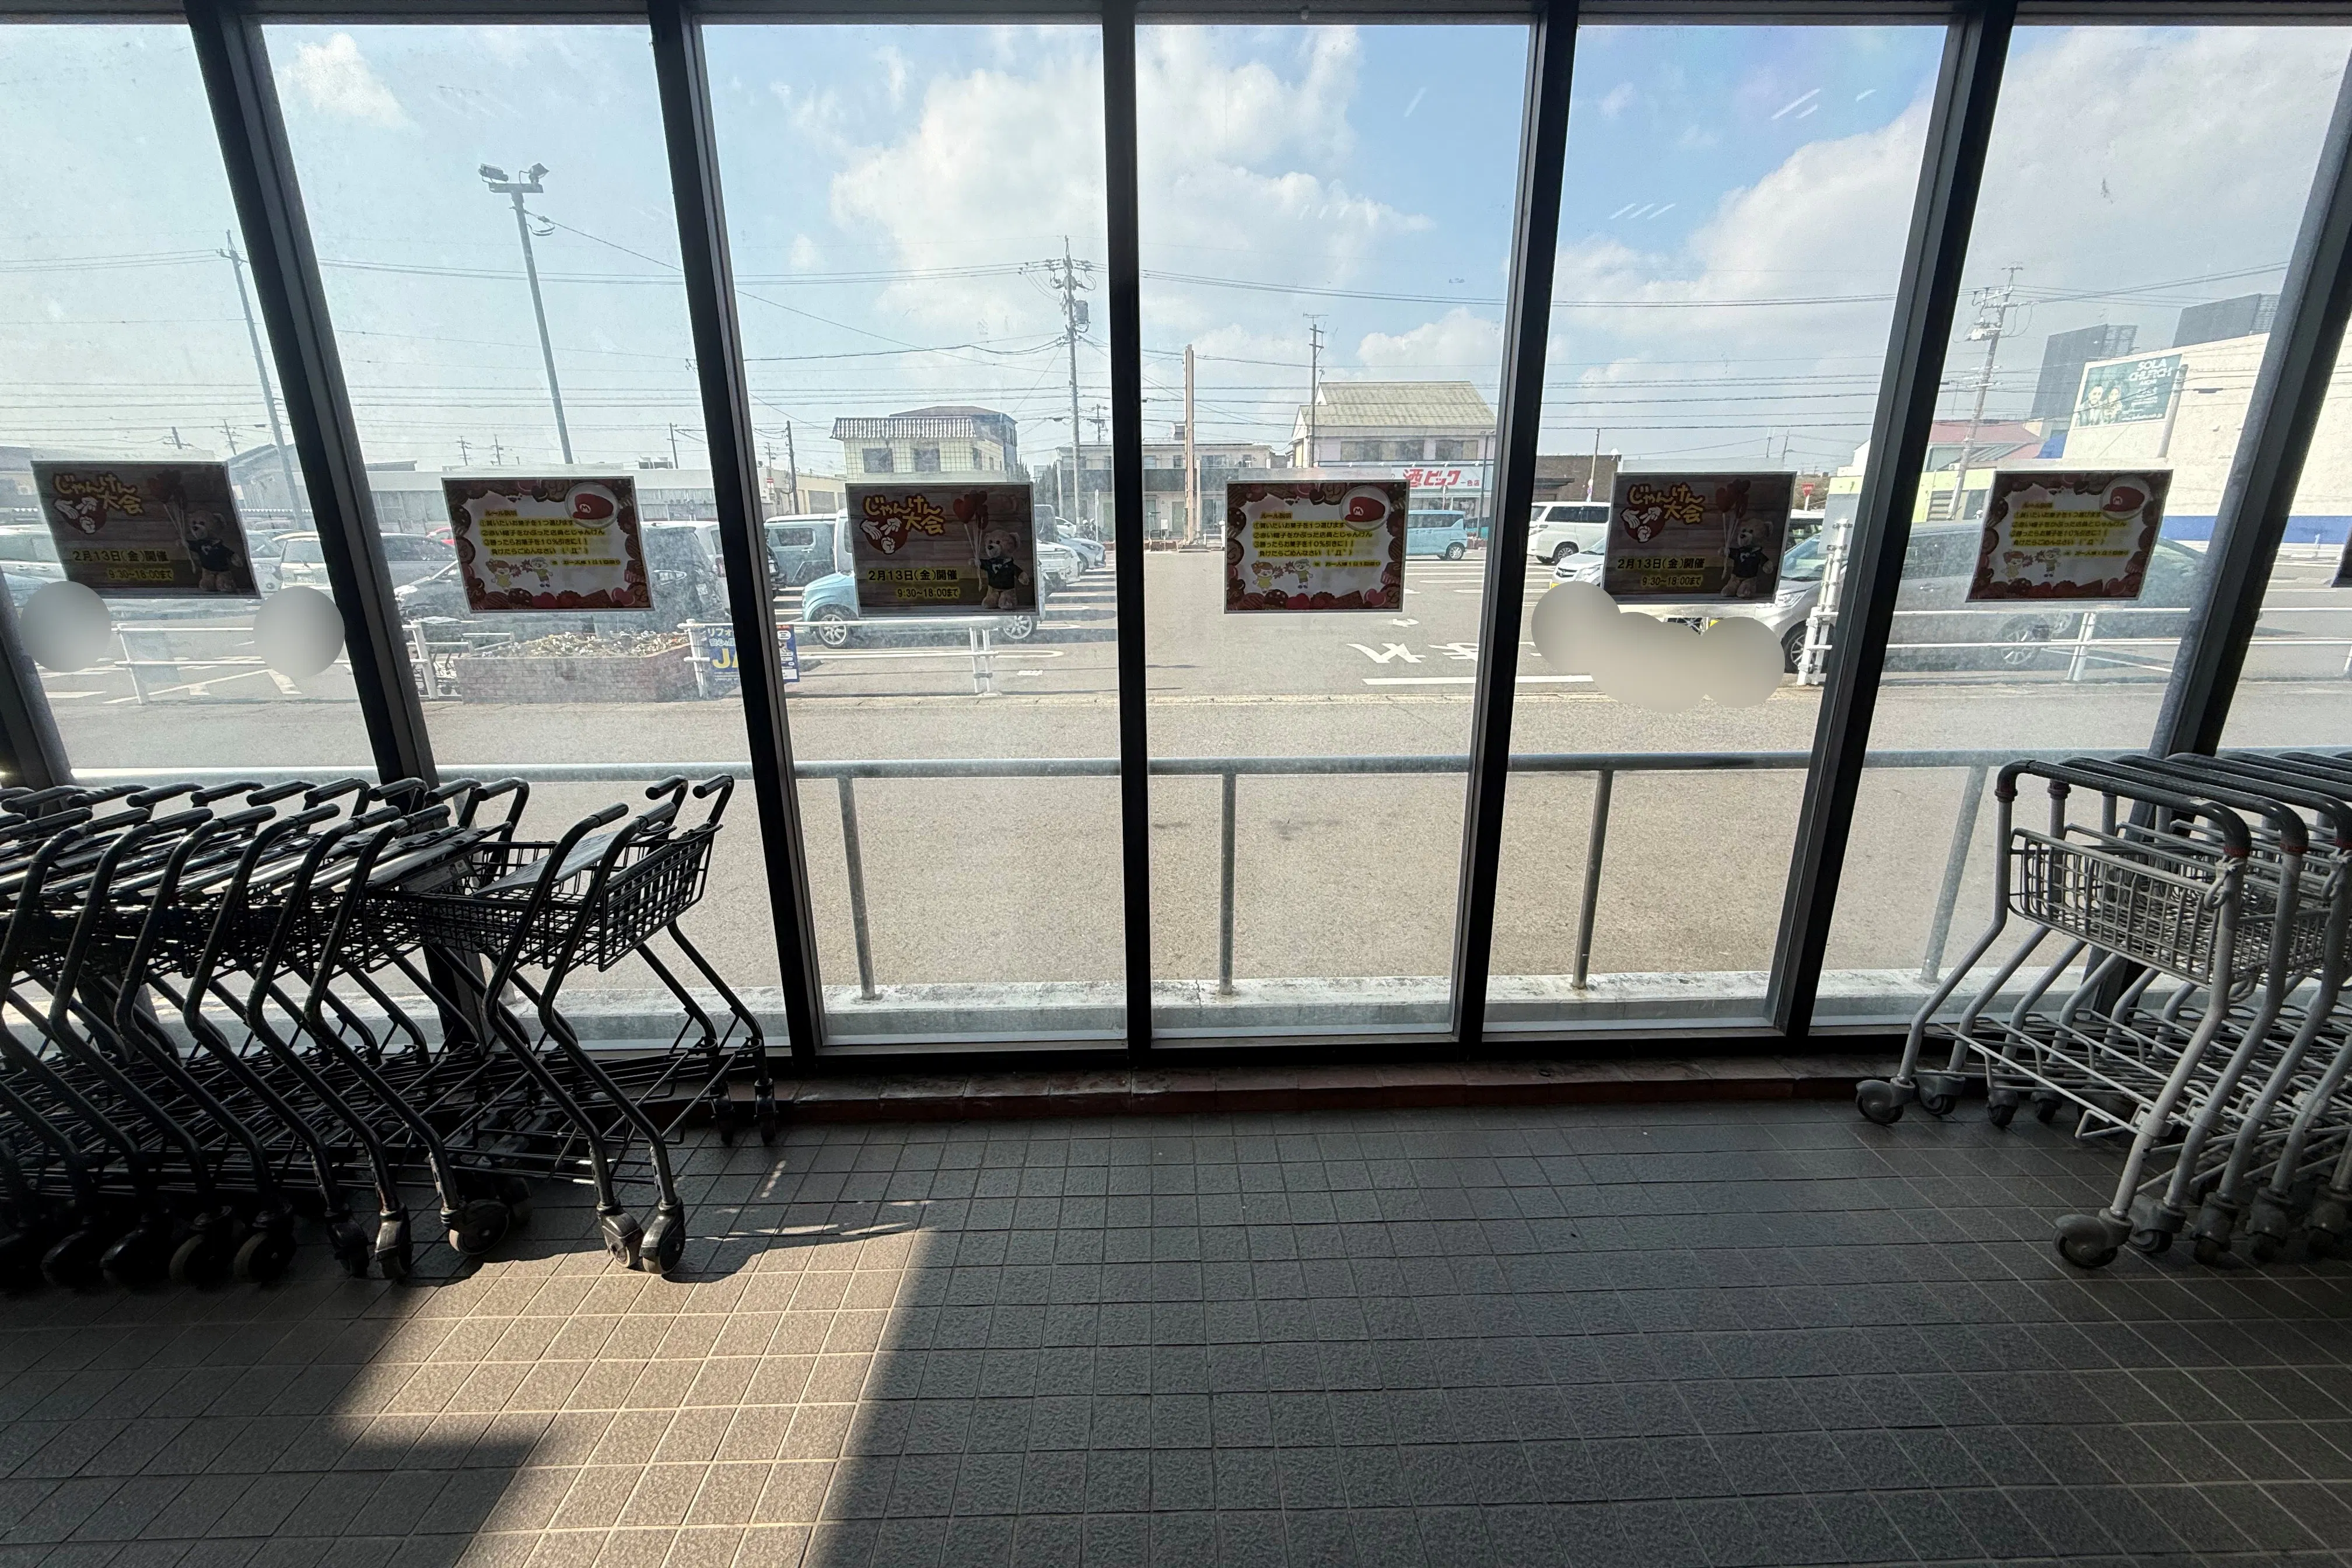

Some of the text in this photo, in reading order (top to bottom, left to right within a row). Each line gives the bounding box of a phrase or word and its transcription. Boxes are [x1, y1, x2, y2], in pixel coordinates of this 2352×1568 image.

[2137, 358, 2167, 371] SOLA
[54, 473, 136, 495] じゃんけん
[1403, 468, 1461, 487] 酒ビック
[96, 490, 144, 514] 大会
[1629, 484, 1704, 505] じゃんけん
[864, 495, 942, 516] じゃんけん
[1664, 501, 1704, 524] 大会
[902, 512, 944, 534] 大会
